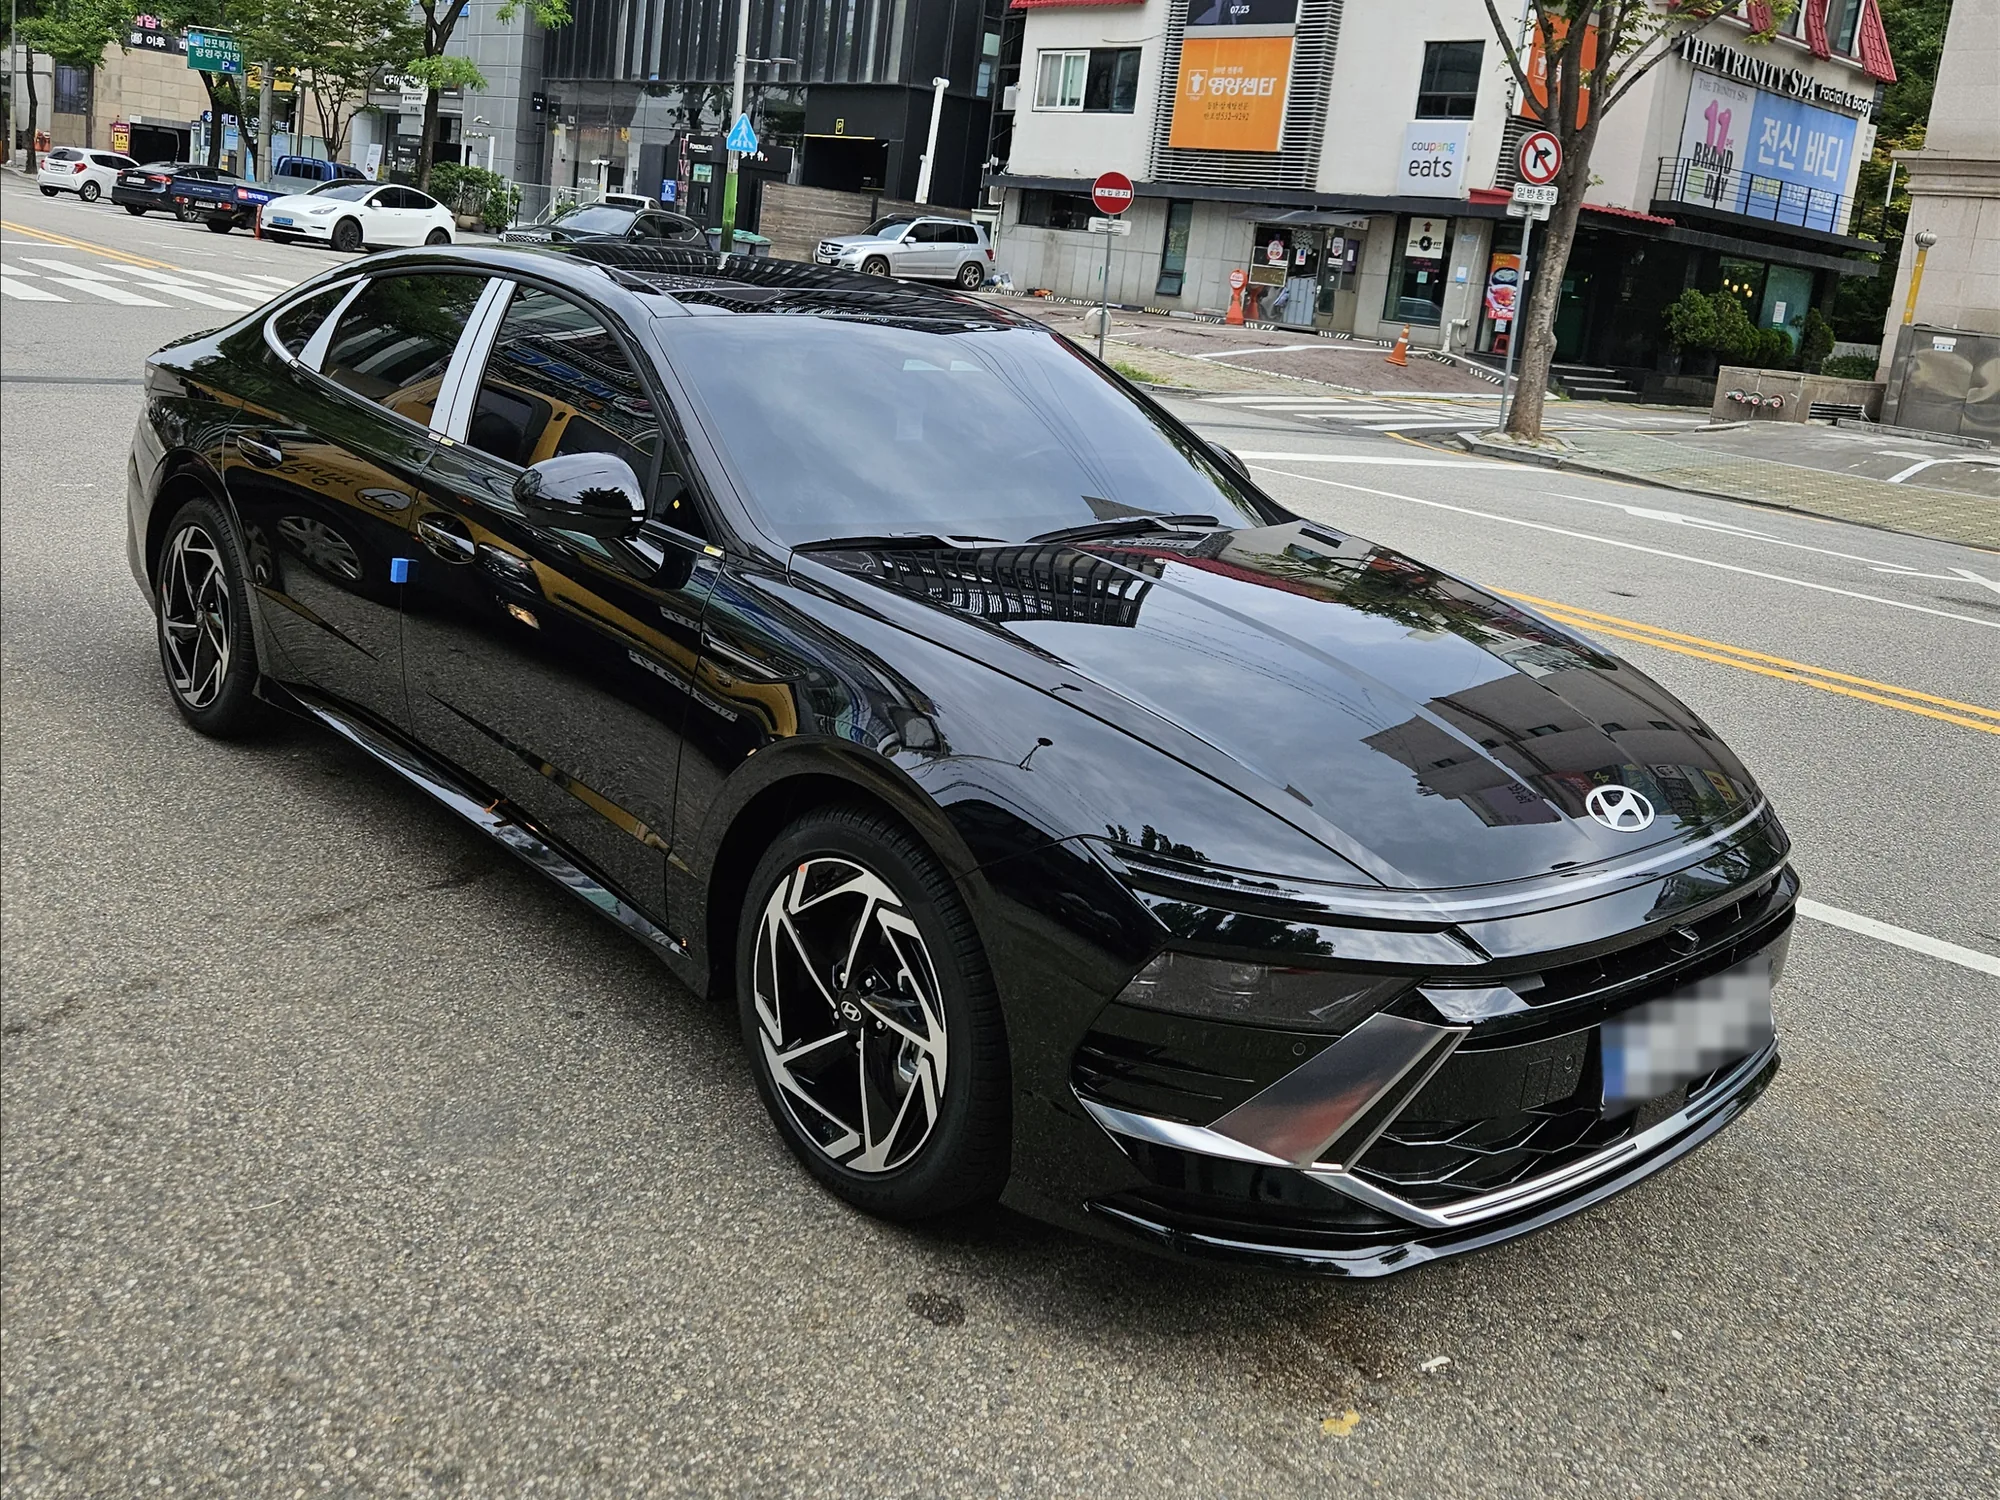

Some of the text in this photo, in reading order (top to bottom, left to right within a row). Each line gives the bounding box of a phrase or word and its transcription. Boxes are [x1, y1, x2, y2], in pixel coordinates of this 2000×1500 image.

[1230, 5, 1250, 14] 07.23
[1681, 33, 1716, 69] THE
[1721, 44, 1788, 91] TRINITY
[1788, 67, 1816, 101] SPA
[1820, 84, 1844, 105] Facial
[1852, 95, 1873, 116] Body
[1208, 77, 1277, 96] 영양센터
[1411, 141, 1456, 155] coupang
[1692, 141, 1733, 174] BRAND
[1757, 117, 1801, 171] 전신
[1803, 130, 1844, 182] 바디
[1408, 156, 1453, 178] eats
[1517, 187, 1555, 201] 일방통행
